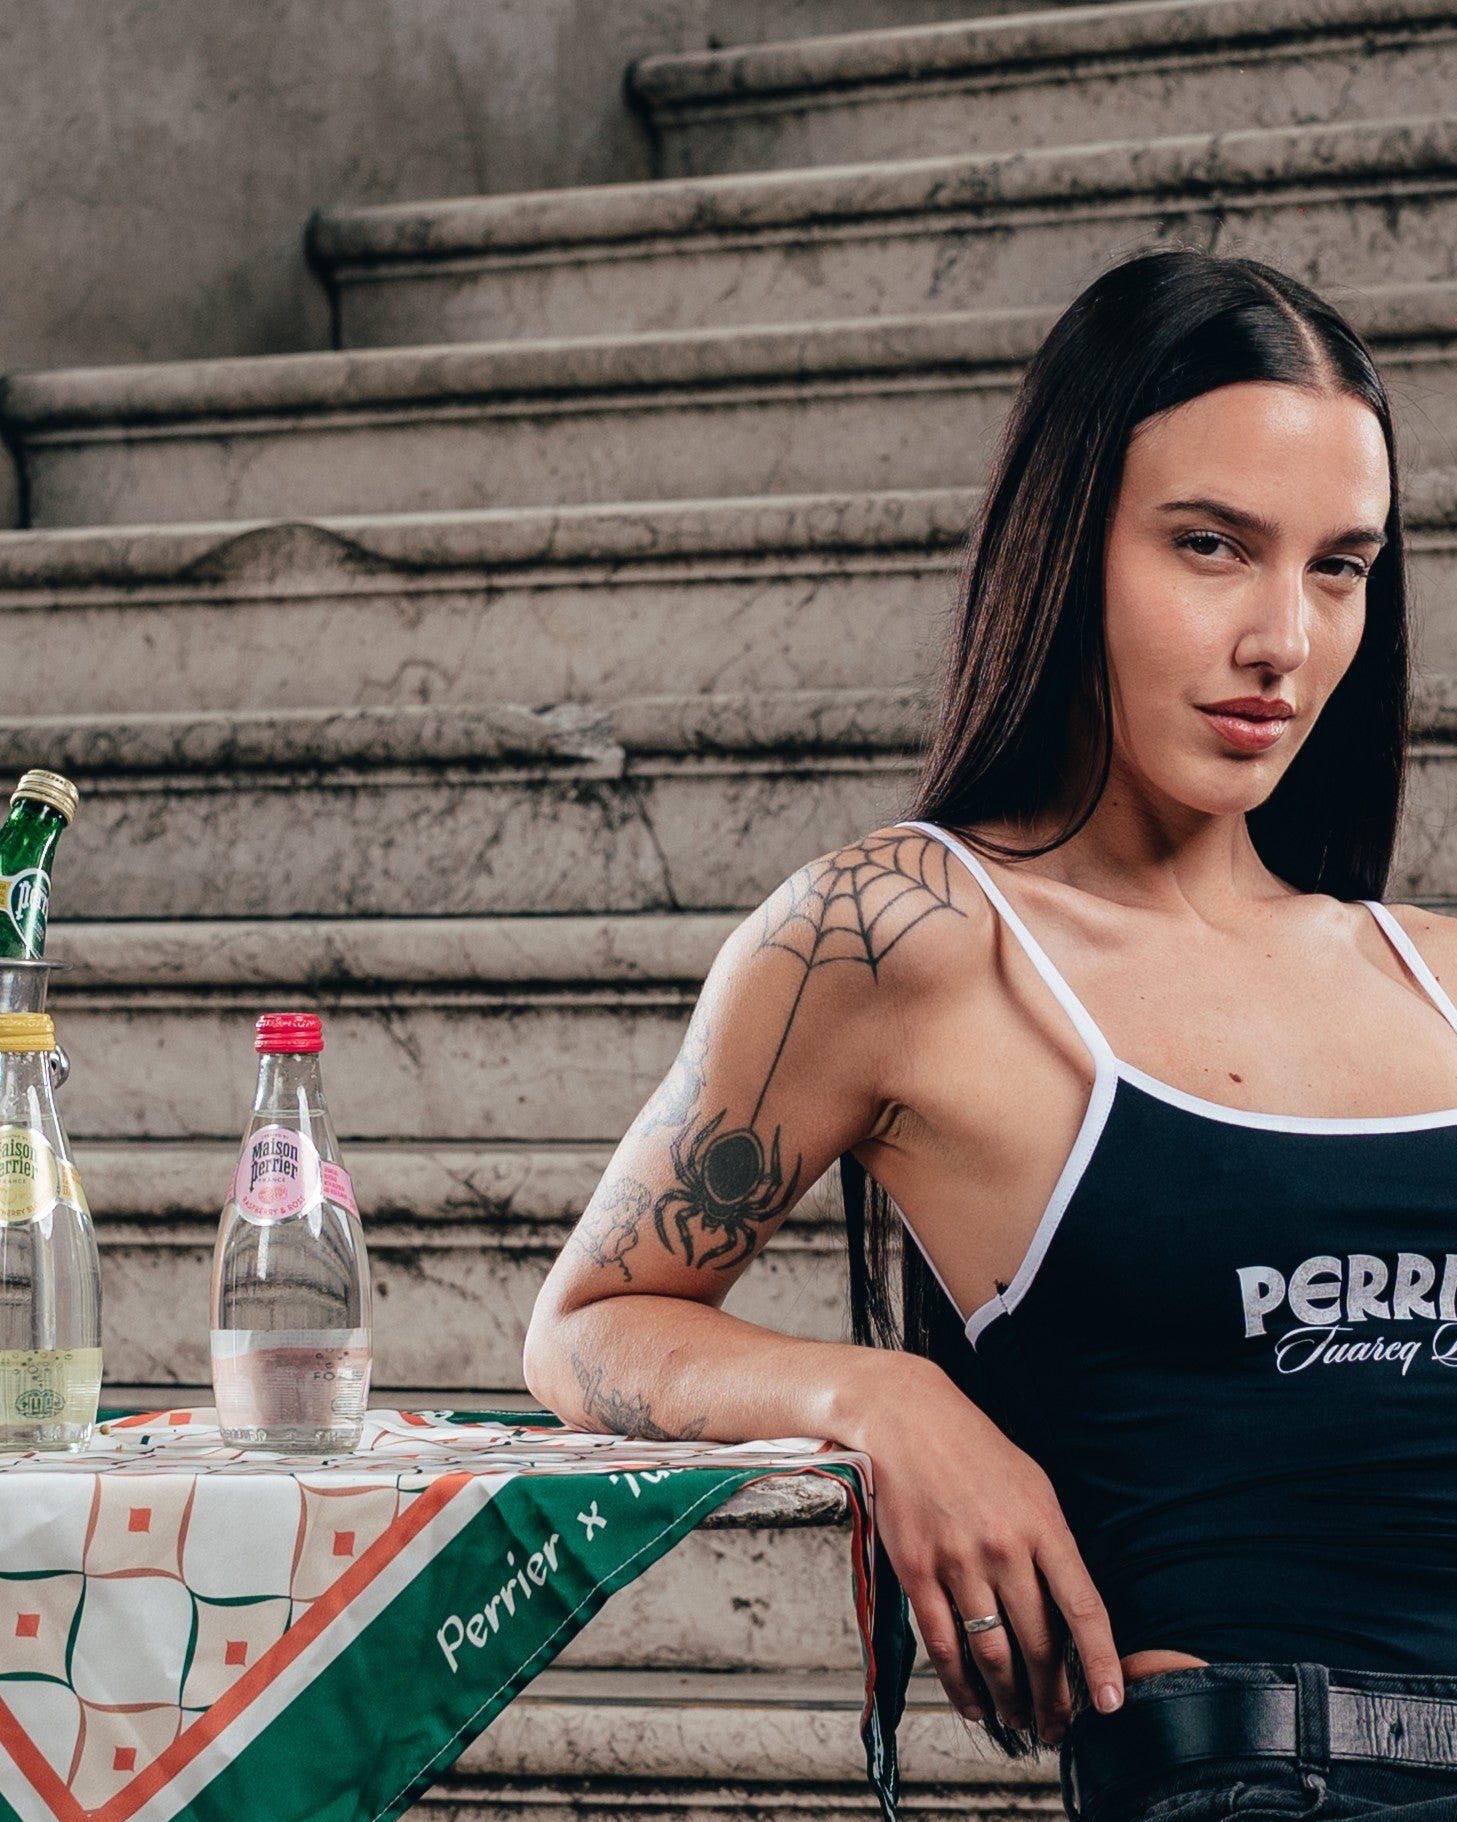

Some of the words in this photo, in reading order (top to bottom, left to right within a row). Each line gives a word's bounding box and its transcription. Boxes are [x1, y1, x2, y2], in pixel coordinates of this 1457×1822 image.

[0, 1138, 37, 1163] aison
[252, 1137, 298, 1162] Maison
[0, 1156, 38, 1180] errier
[436, 1531, 560, 1673] Perrier
